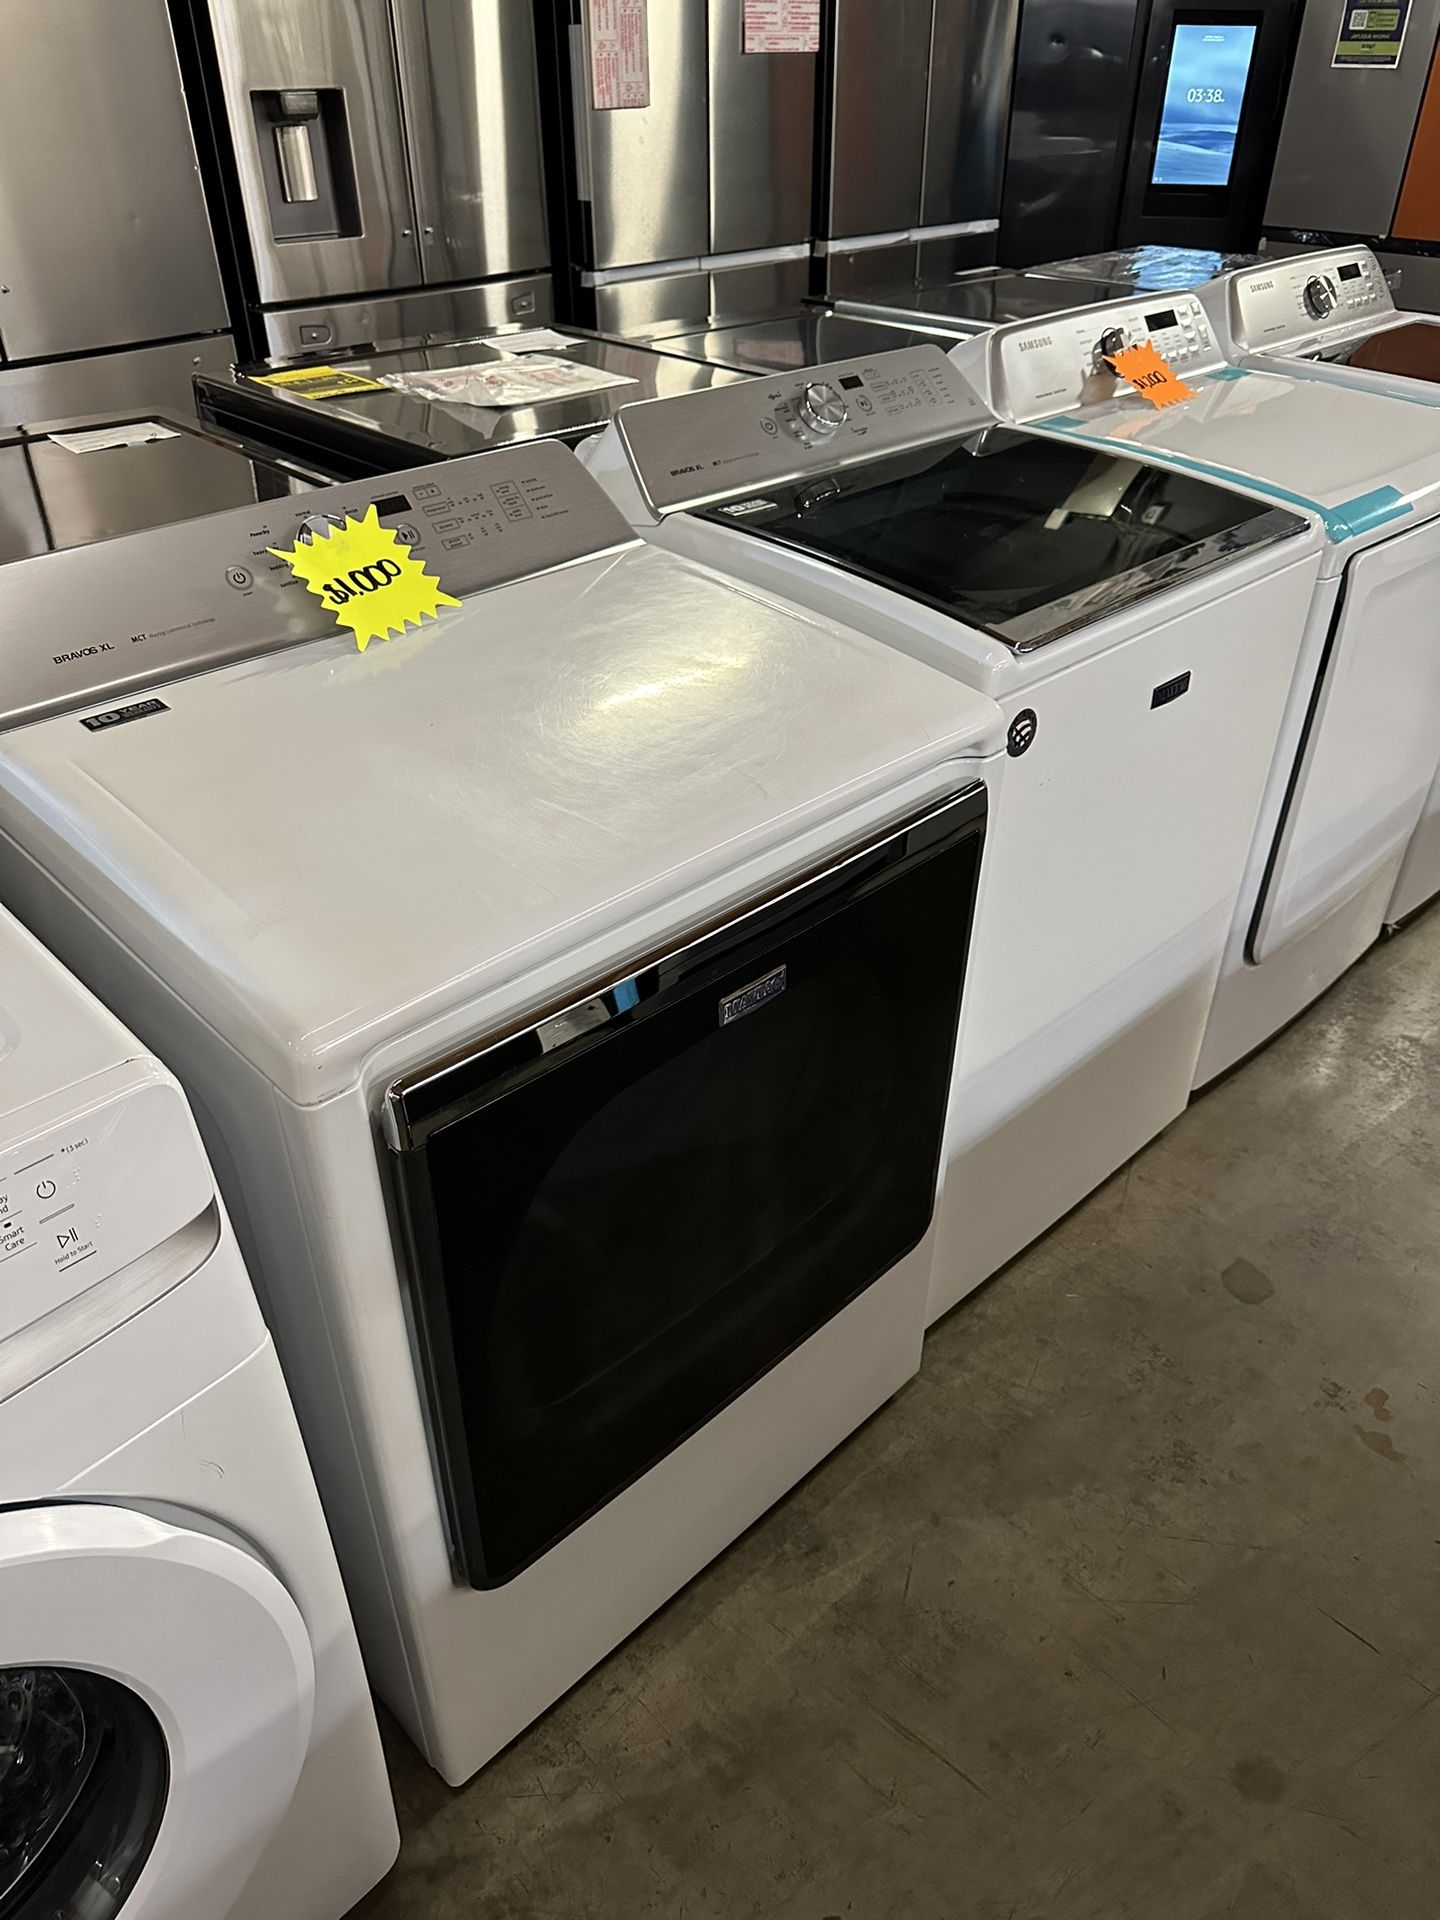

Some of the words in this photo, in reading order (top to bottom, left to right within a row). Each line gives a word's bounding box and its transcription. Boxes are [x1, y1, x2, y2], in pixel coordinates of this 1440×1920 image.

[1250, 280, 1274, 293] SAMSUNG
[1018, 336, 1052, 352] SAMSUNG
[322, 558, 402, 604] $1,000
[131, 633, 147, 643] MCT
[53, 646, 98, 664] BRAVOS
[98, 643, 115, 651] XL
[86, 712, 121, 727] 10
[5, 1238, 24, 1251] Care
[55, 1253, 69, 1264] Hold
[77, 1241, 93, 1252] Start
